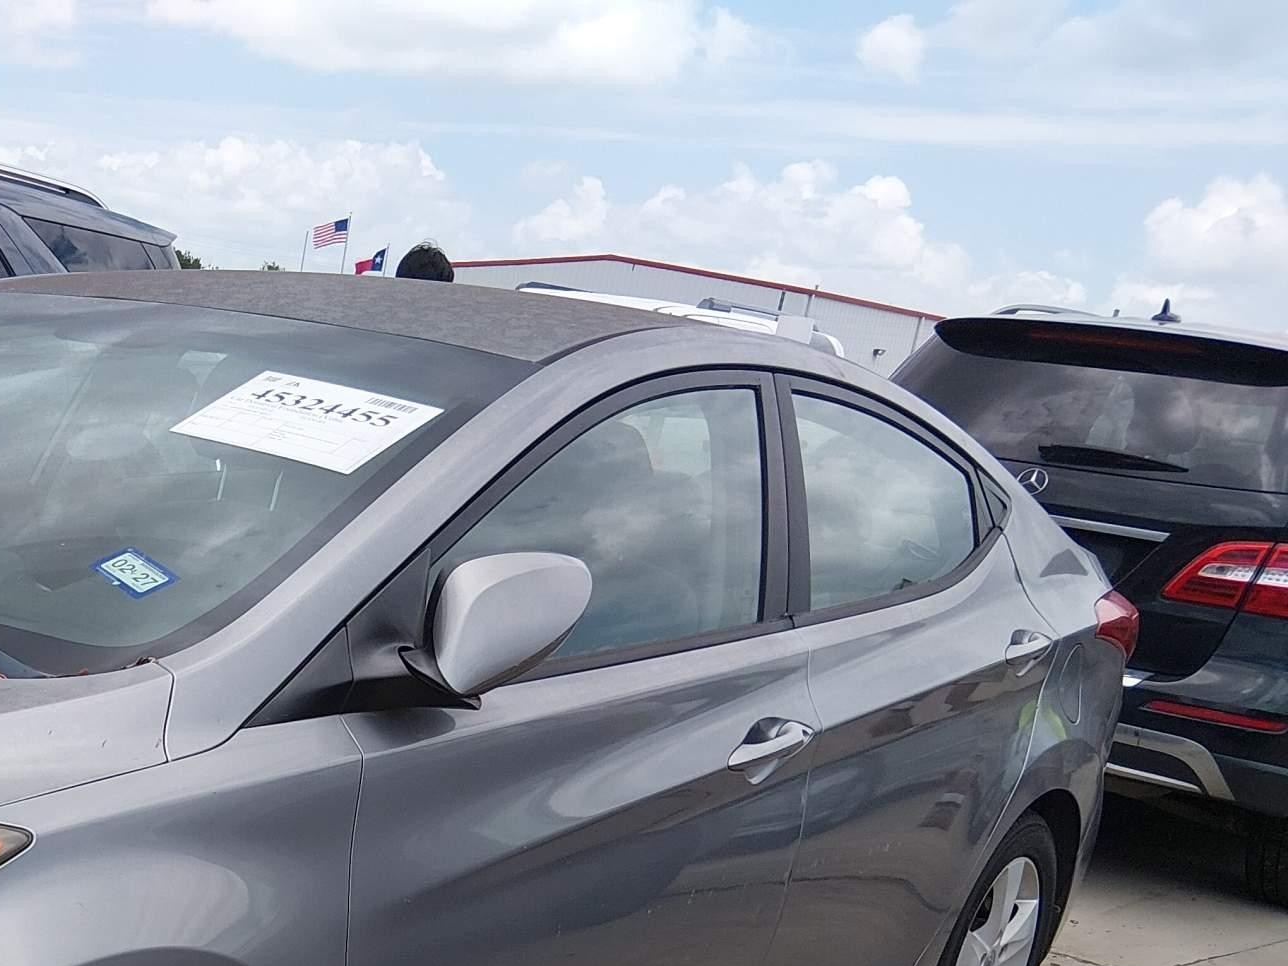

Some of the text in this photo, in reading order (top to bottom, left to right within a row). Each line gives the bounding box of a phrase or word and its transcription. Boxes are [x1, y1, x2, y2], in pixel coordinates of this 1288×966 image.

[250, 388, 400, 428] 45324455
[111, 559, 136, 575] 02
[132, 572, 160, 586] 27
